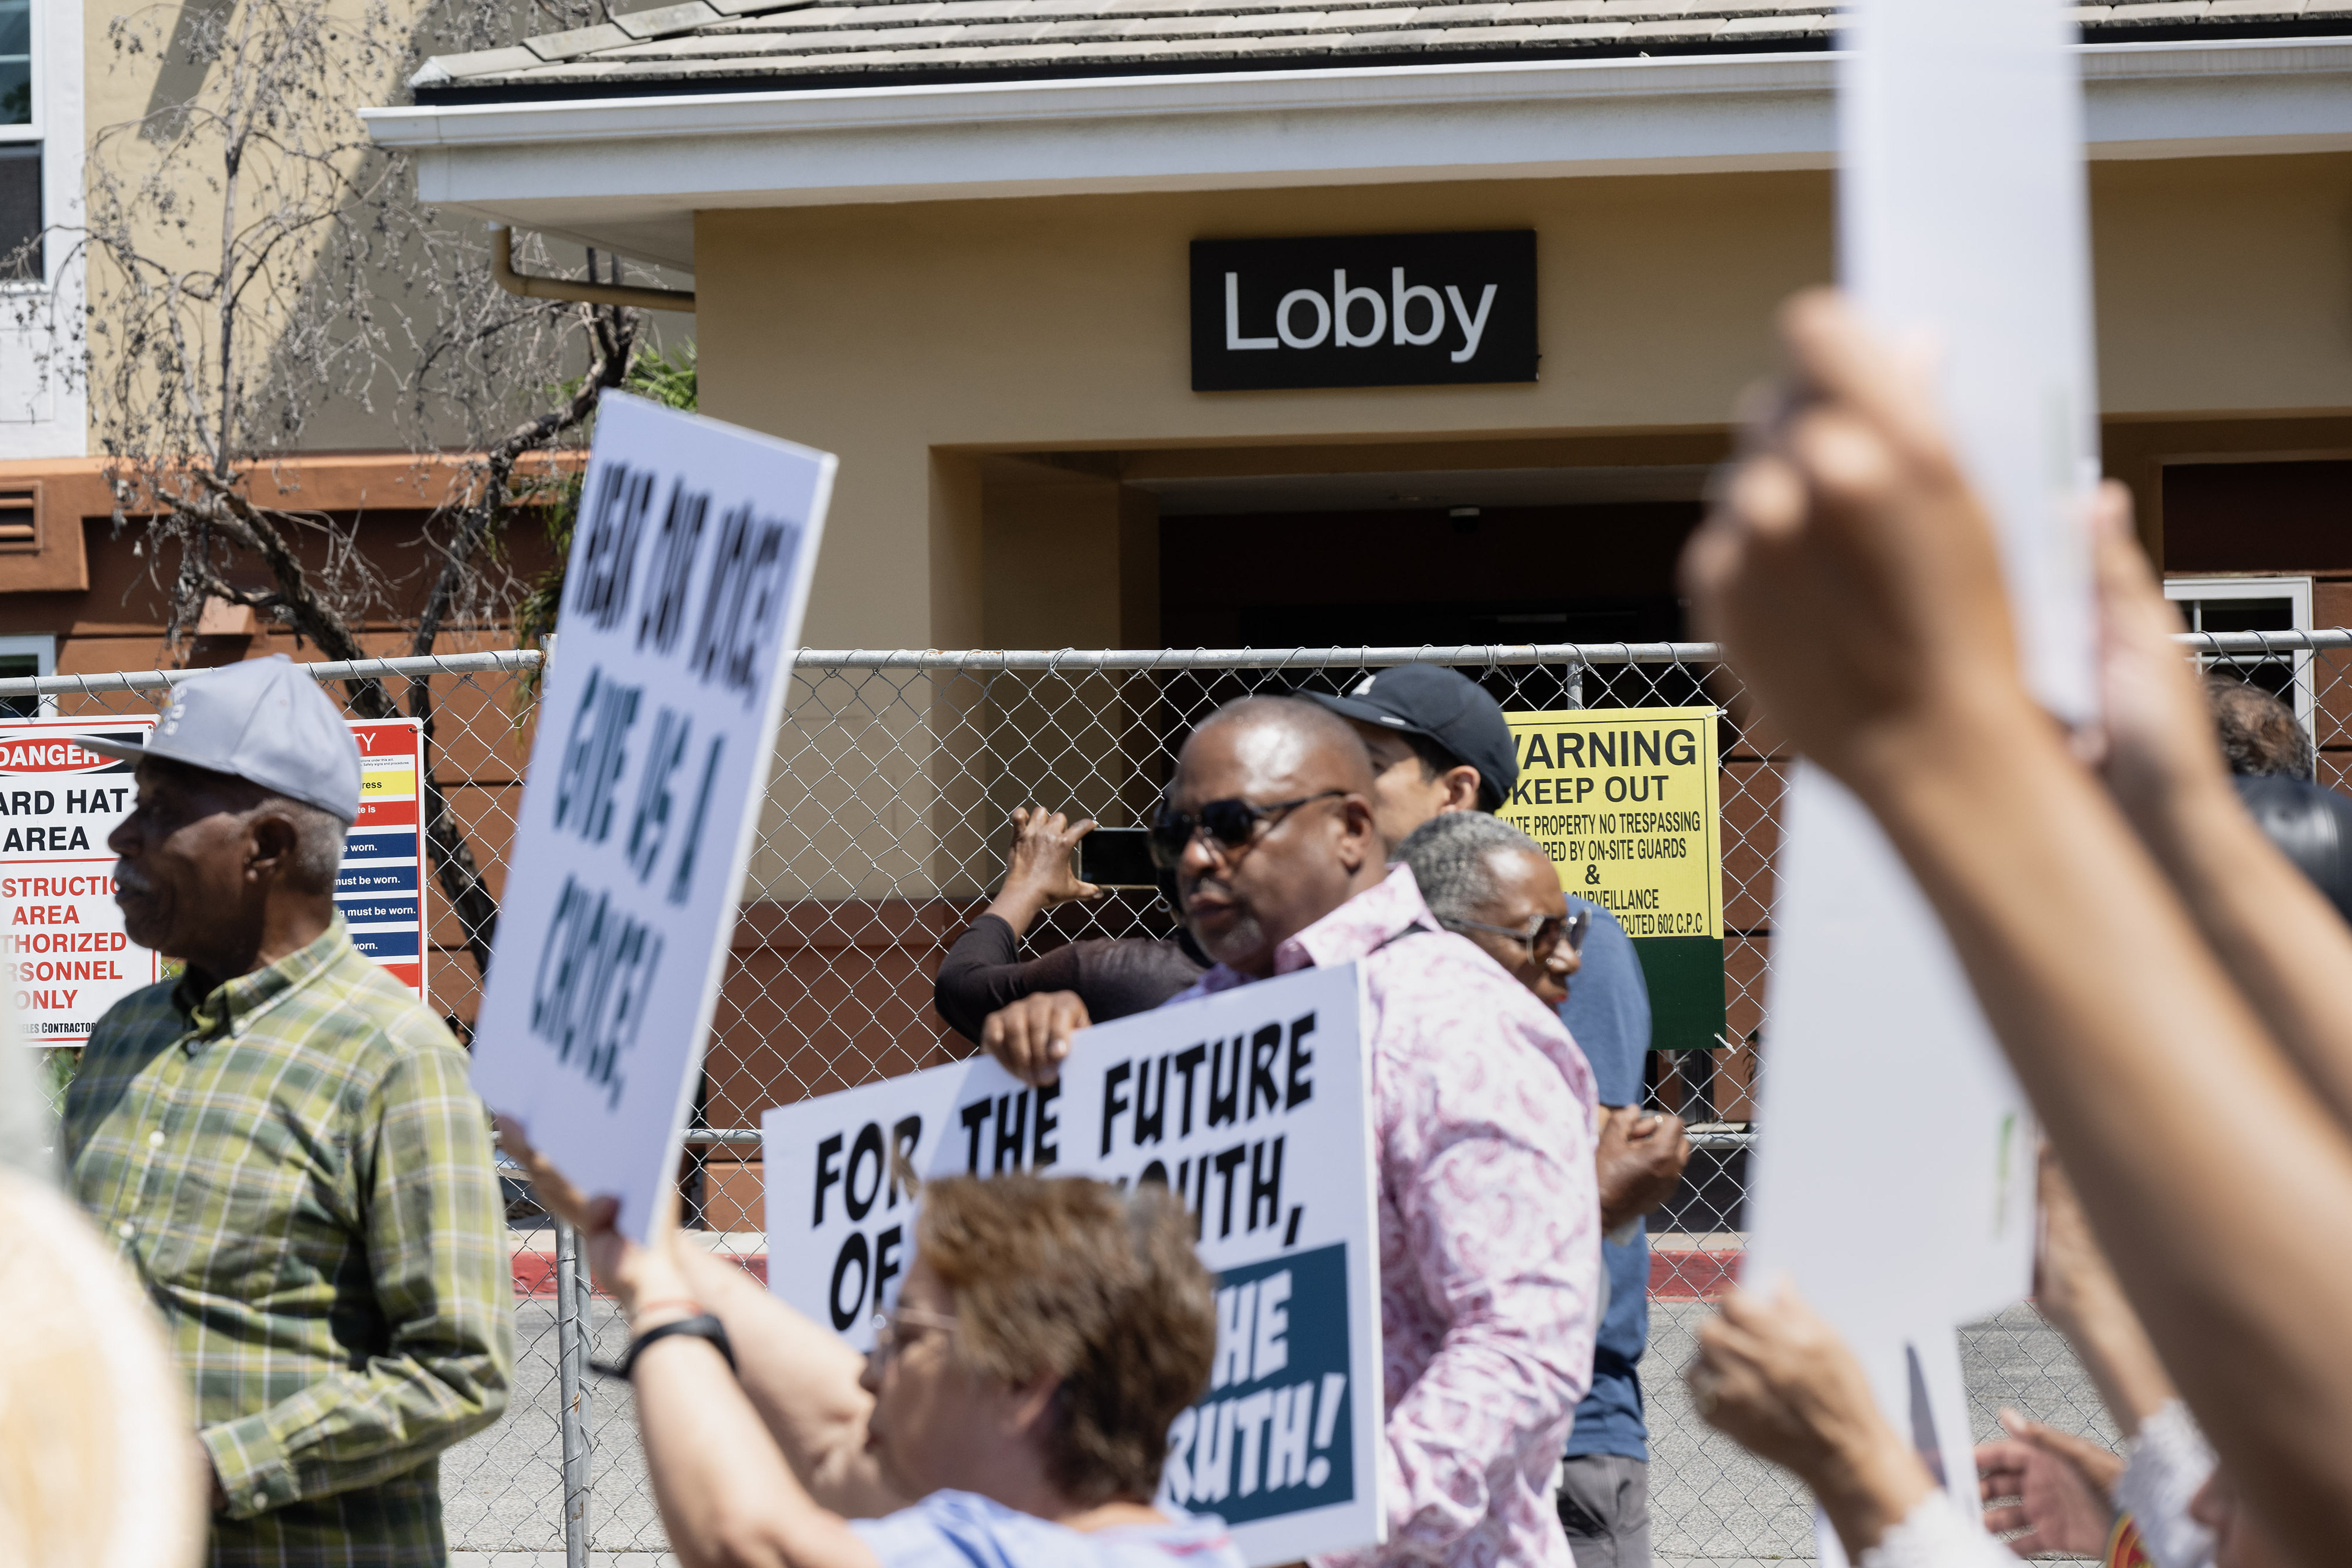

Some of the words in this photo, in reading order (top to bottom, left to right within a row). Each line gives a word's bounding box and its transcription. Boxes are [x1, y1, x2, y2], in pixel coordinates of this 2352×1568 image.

[1225, 267, 1497, 363] Lobby
[1514, 729, 1696, 770] ARNING
[67, 788, 129, 814] HAT
[1512, 777, 1594, 805] KEEP
[1605, 775, 1669, 802] OUT
[368, 805, 376, 813] is
[1534, 814, 1595, 836] PROPERTY
[1600, 813, 1616, 834] NO
[1619, 811, 1700, 833] TRESPASSING
[2, 826, 90, 852] AREA
[1537, 841, 1566, 862] RED
[1570, 841, 1585, 861] BY
[1589, 840, 1634, 861] ON-SITE
[1638, 838, 1686, 859] GUARDS
[334, 877, 357, 886] must
[359, 876, 371, 885] be
[374, 876, 400, 884] worn.
[1585, 864, 1601, 885] &
[12, 905, 80, 925] AREA
[348, 907, 372, 916] must
[375, 907, 387, 916] be
[389, 907, 416, 915] worn.
[1658, 913, 1674, 935] 602
[1677, 913, 1702, 934] C.P.C
[351, 942, 378, 951] worn.
[15, 989, 78, 1010] ONLY
[812, 1111, 922, 1229] FOR
[960, 1077, 1061, 1178] THE
[1100, 1010, 1317, 1160] FUTURE
[830, 1225, 903, 1332] OF
[1116, 1134, 1303, 1248] UTH,
[1210, 1269, 1292, 1392] HE
